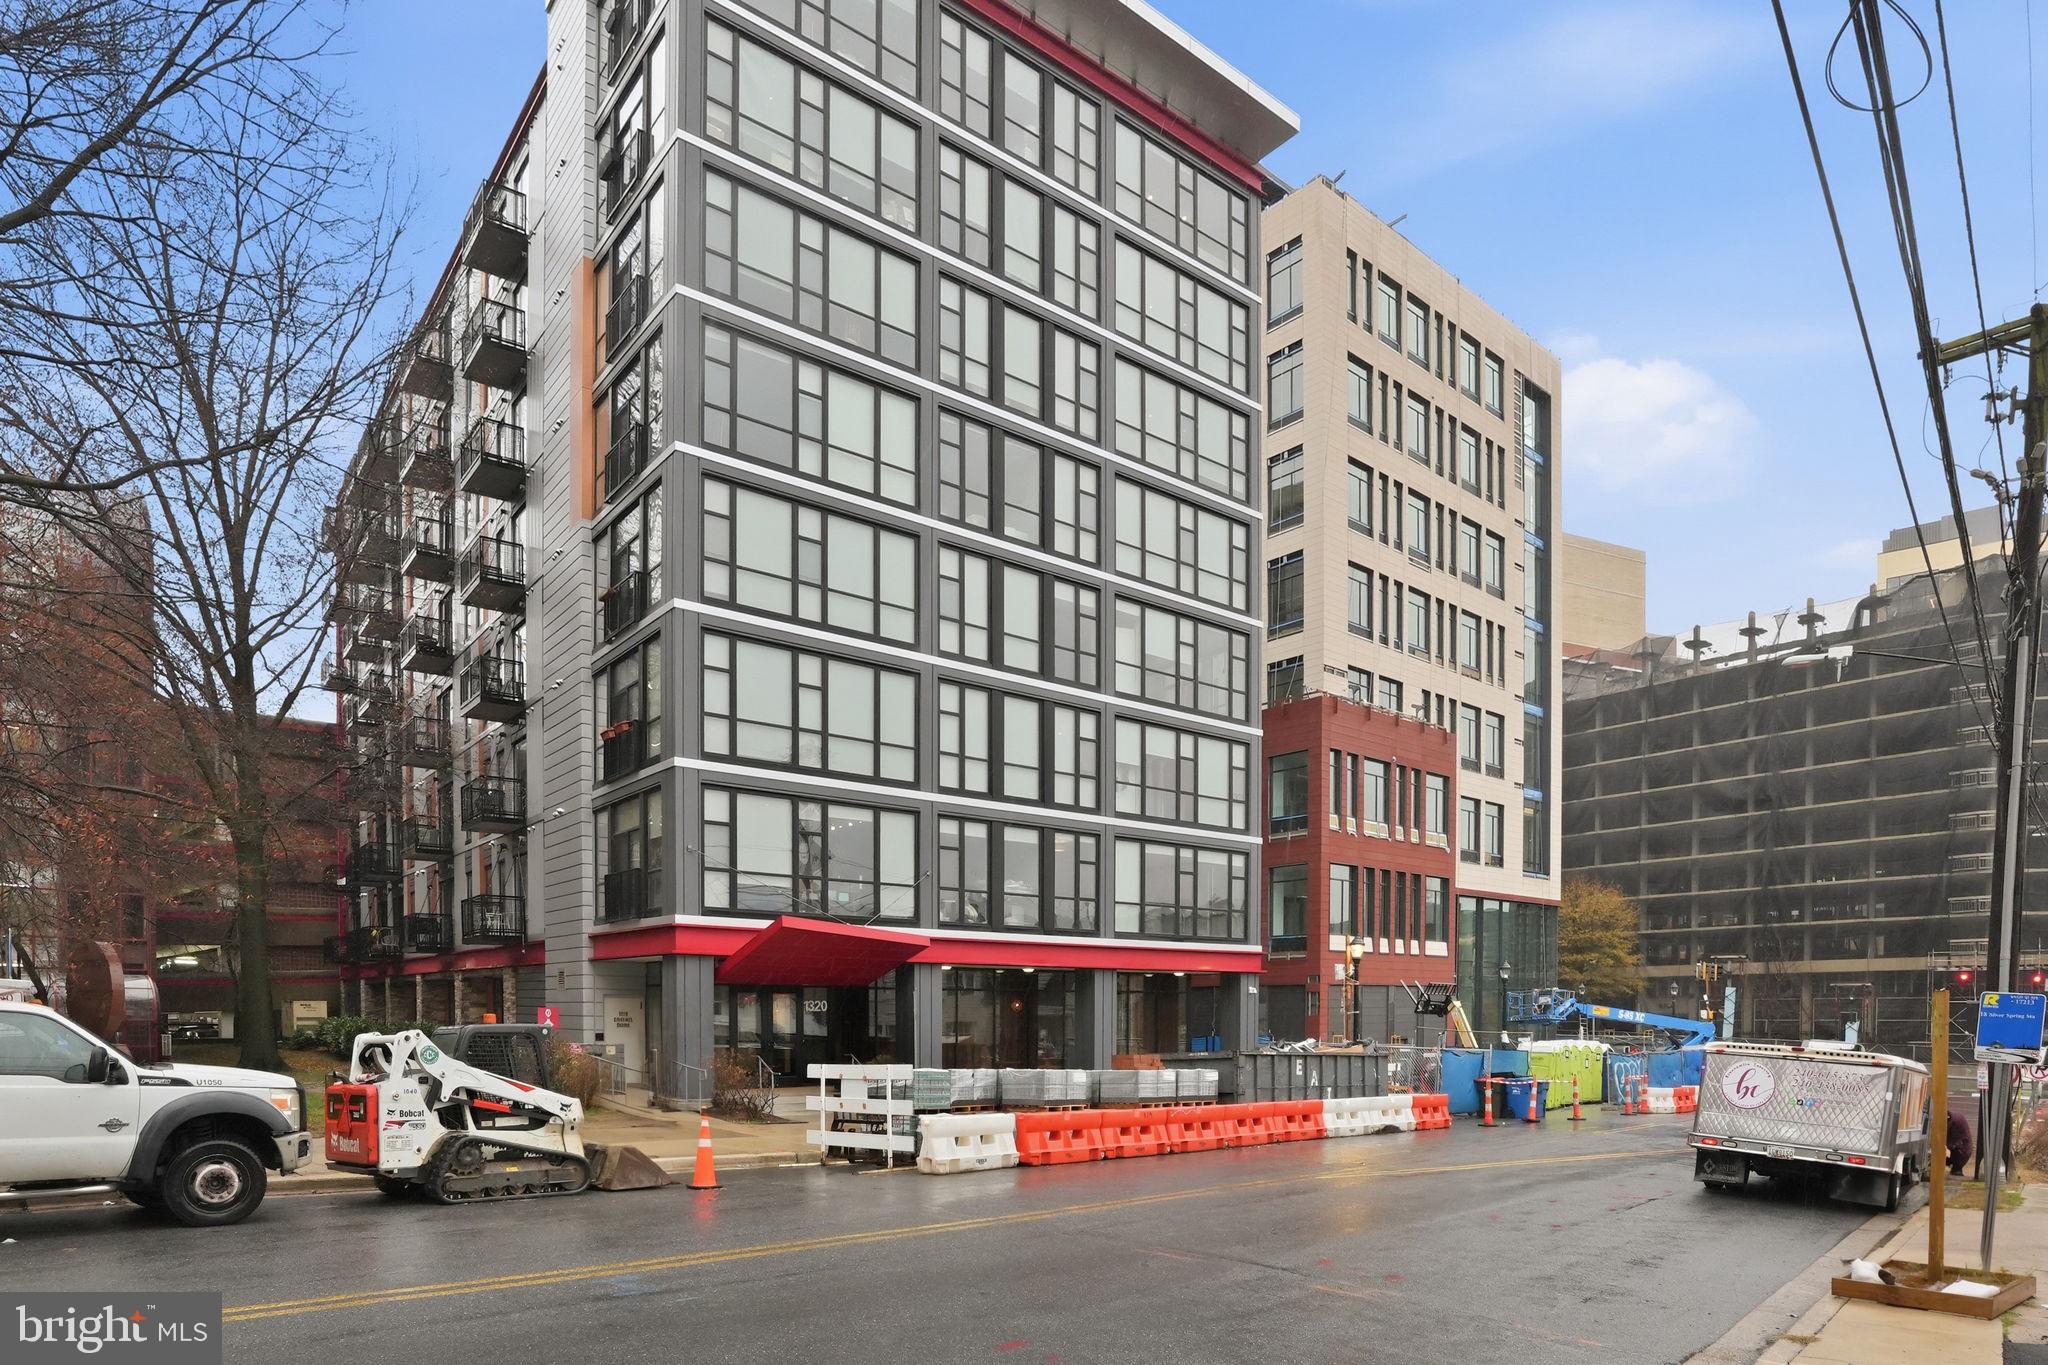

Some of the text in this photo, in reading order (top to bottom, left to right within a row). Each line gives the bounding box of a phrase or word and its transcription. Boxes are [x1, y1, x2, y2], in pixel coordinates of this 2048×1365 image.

[803, 1000, 828, 1012] 1320
[399, 1110, 425, 1118] Bobcat
[339, 1136, 360, 1153] Bobcat
